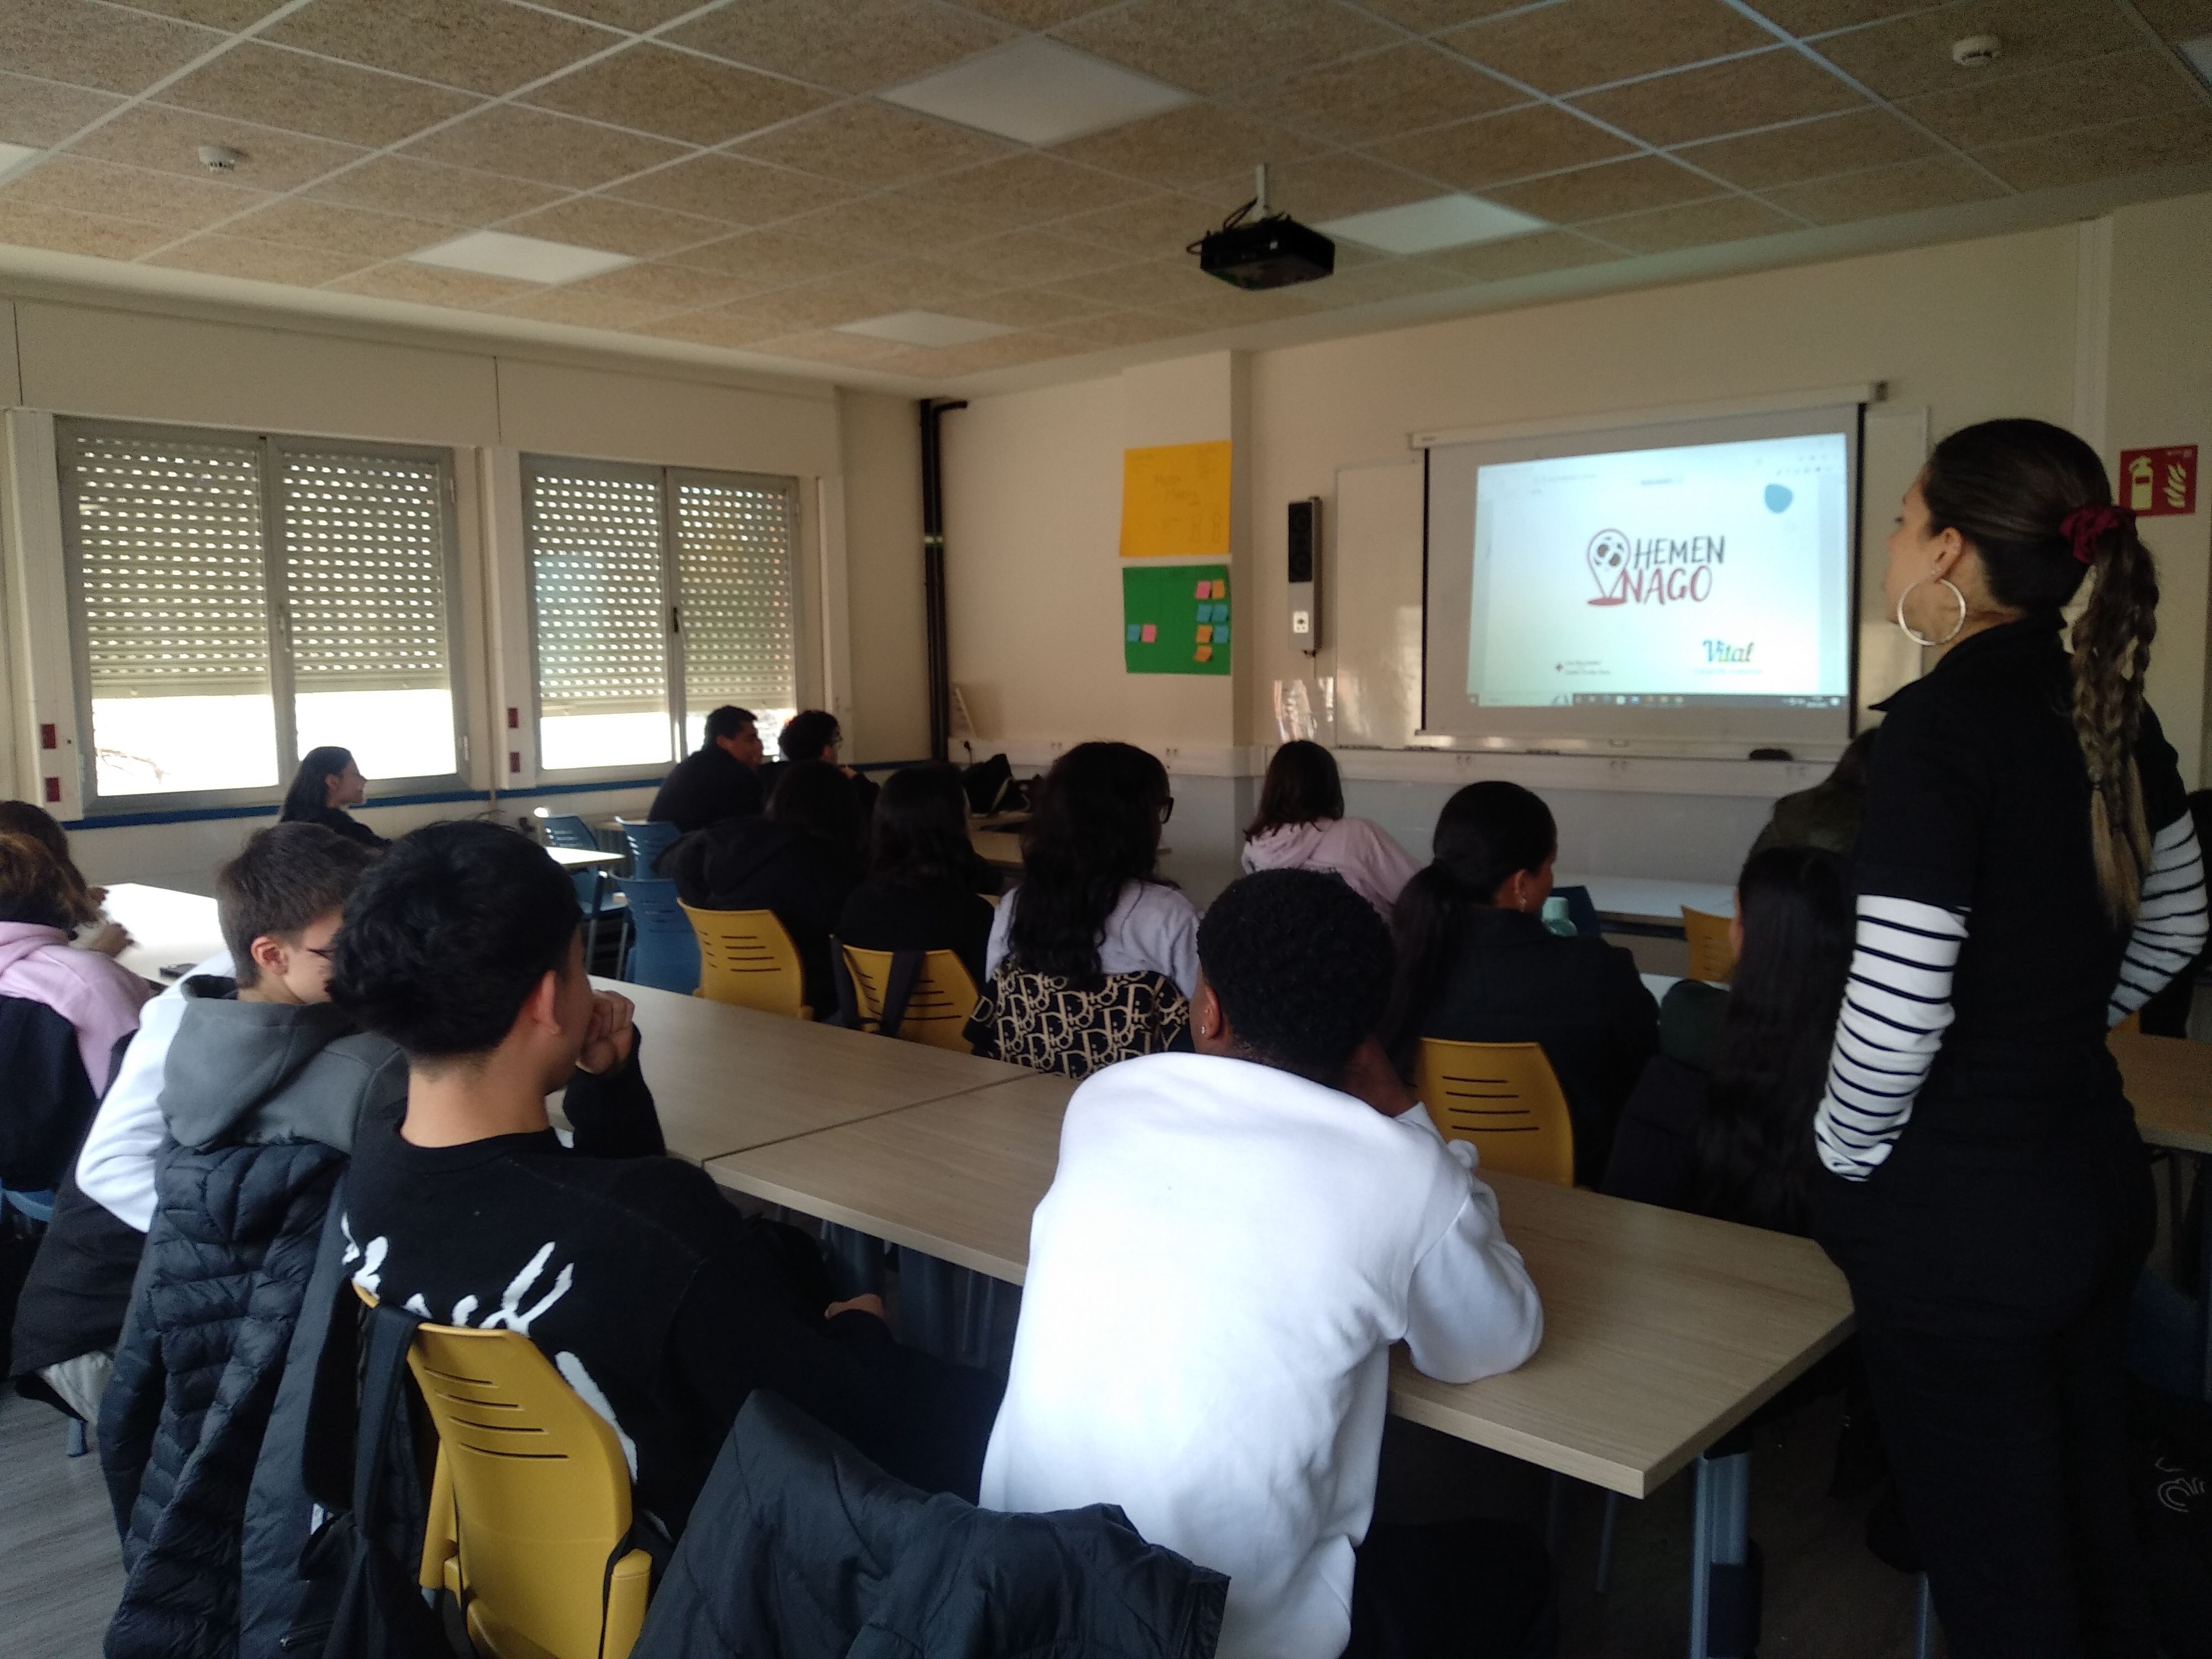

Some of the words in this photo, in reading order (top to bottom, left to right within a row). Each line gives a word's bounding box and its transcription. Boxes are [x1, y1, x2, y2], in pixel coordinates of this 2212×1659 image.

[1633, 534, 1725, 570] HEMEN
[1621, 565, 1713, 605] NAGO
[1702, 639, 1755, 663] Vital
